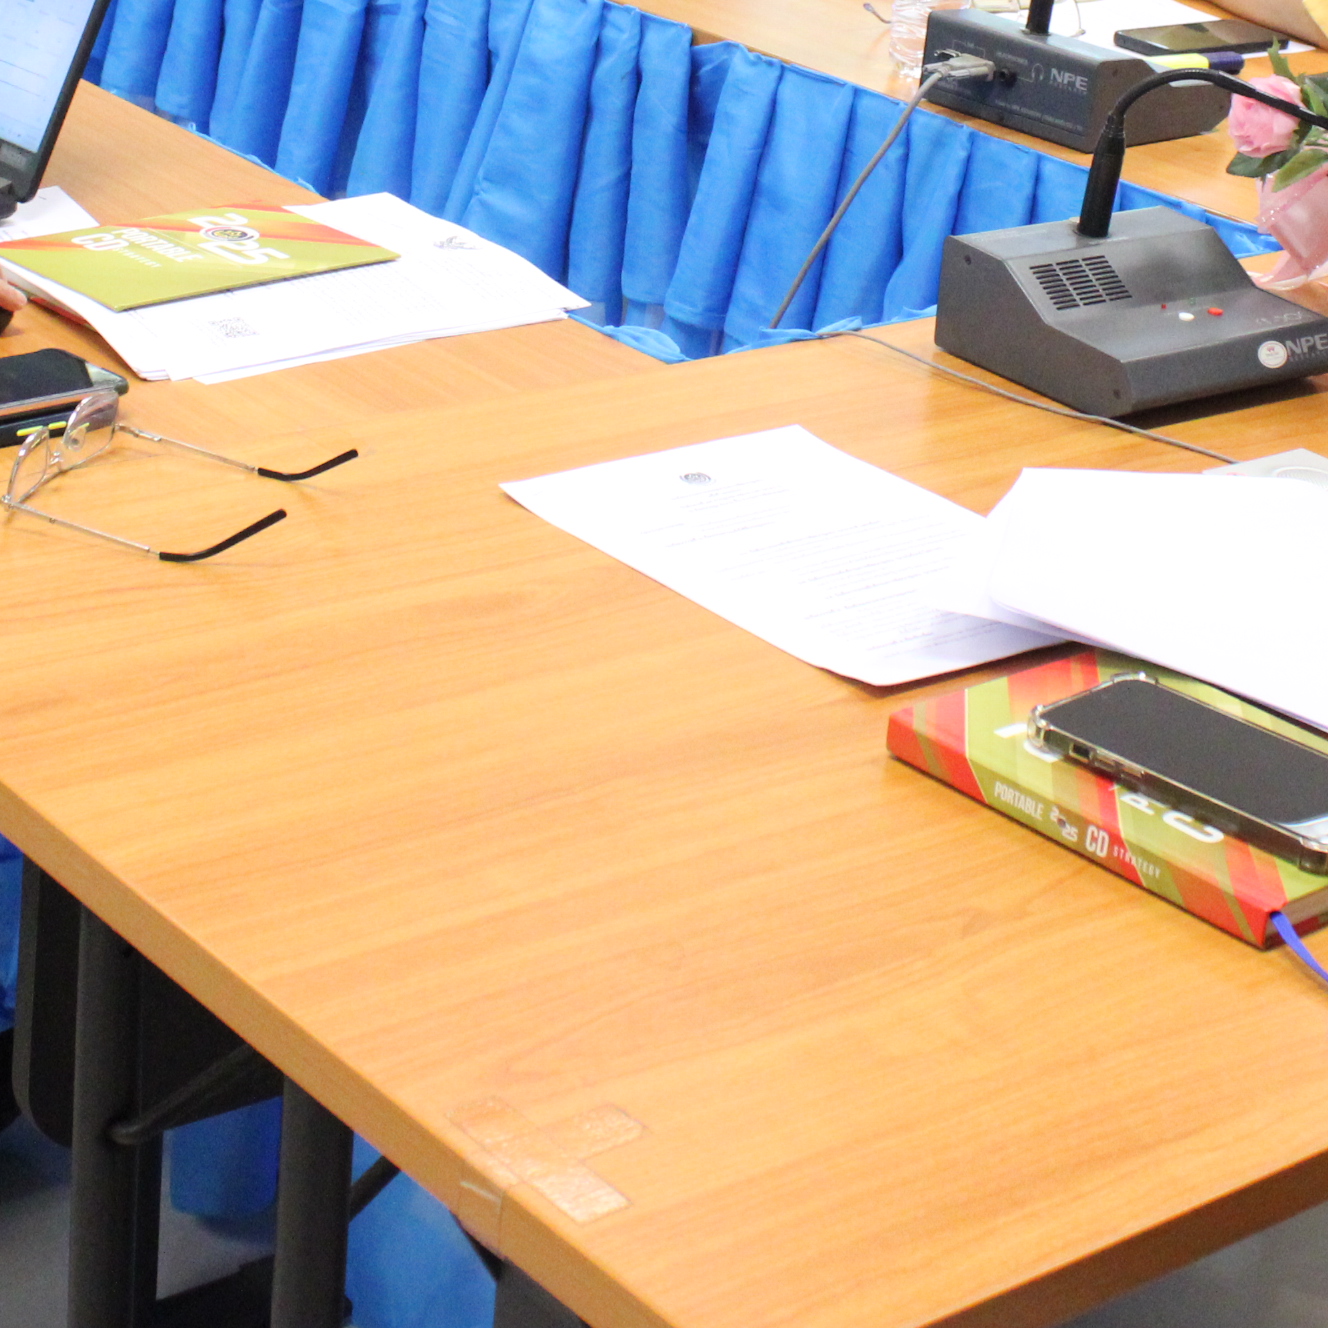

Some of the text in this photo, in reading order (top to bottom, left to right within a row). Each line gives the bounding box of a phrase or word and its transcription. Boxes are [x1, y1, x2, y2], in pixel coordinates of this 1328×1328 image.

[1050, 67, 1089, 91] NPE
[71, 232, 130, 252] CD
[112, 227, 204, 263] PORTABLE
[994, 781, 1044, 821] PORTABLE
[1085, 824, 1110, 859] CD
[1112, 846, 1162, 879] STRATEGY
